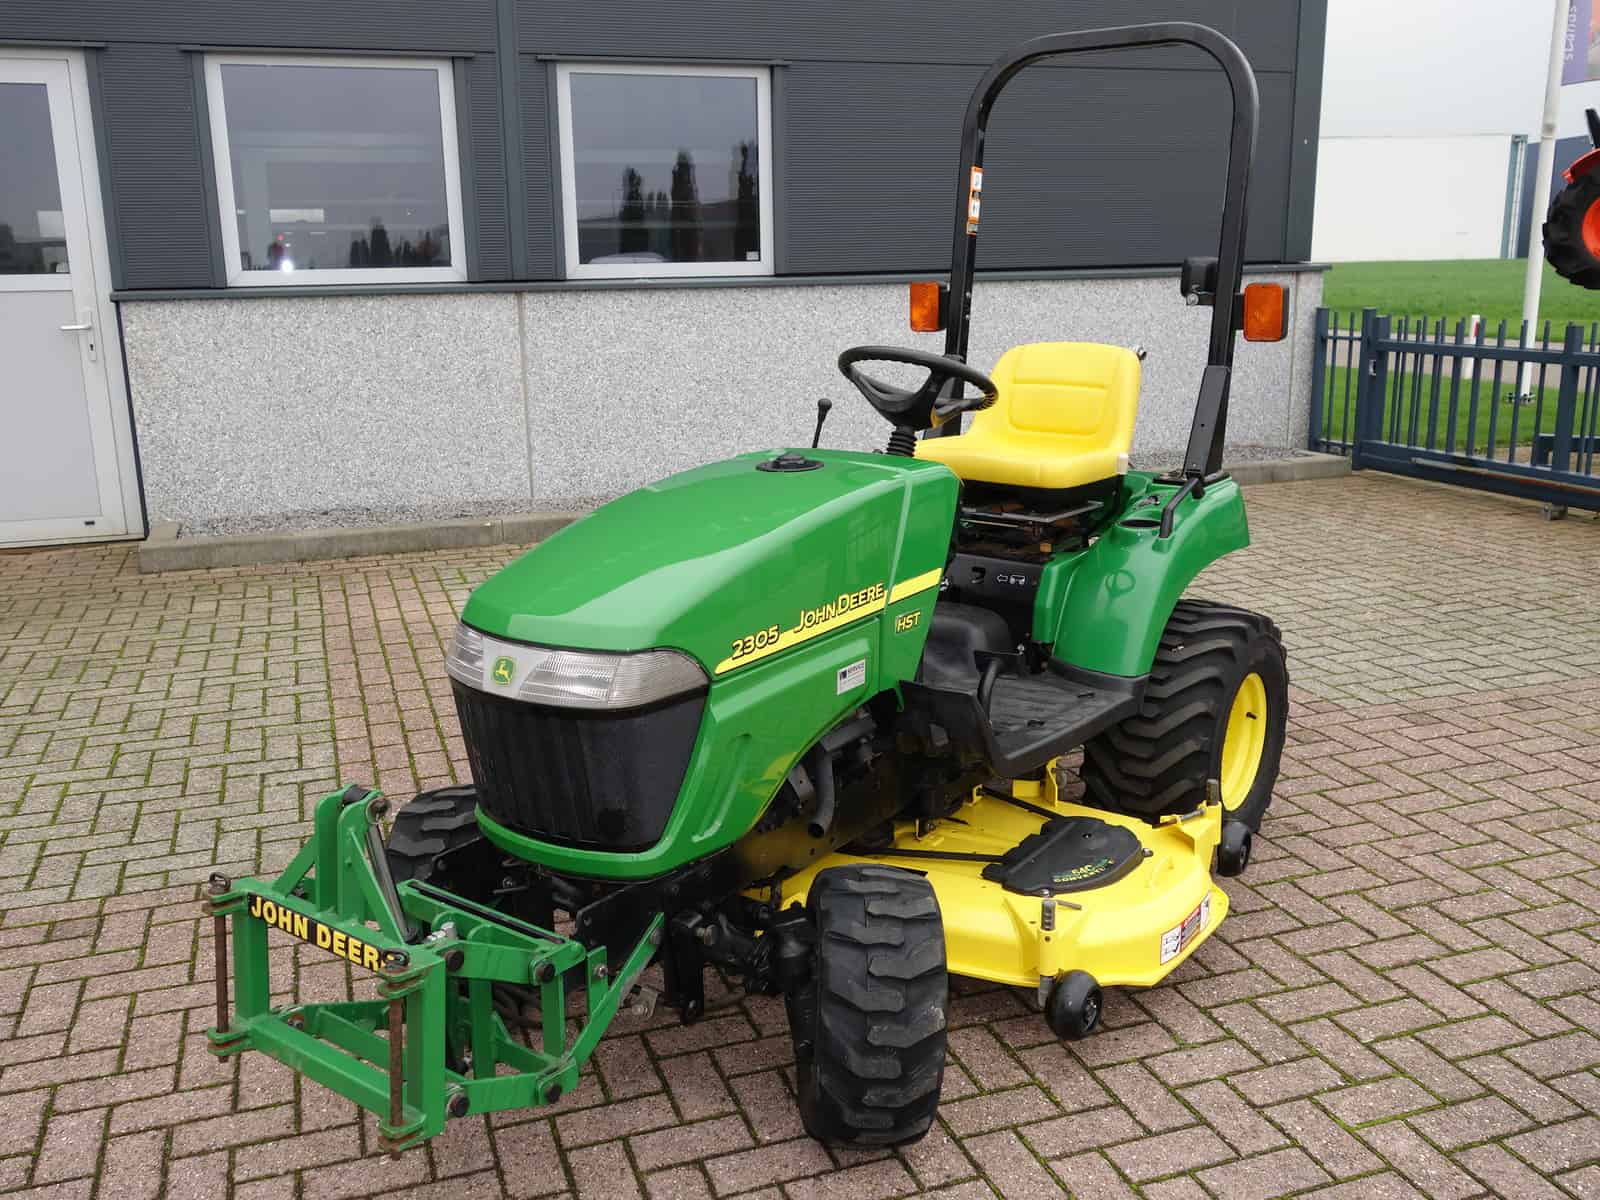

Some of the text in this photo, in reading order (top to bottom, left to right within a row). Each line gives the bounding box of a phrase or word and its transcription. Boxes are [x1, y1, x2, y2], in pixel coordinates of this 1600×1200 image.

[794, 582, 885, 632] JOHN DEERE
[896, 610, 921, 632] HST
[731, 624, 780, 660] 2305
[250, 895, 309, 940] JOHN
